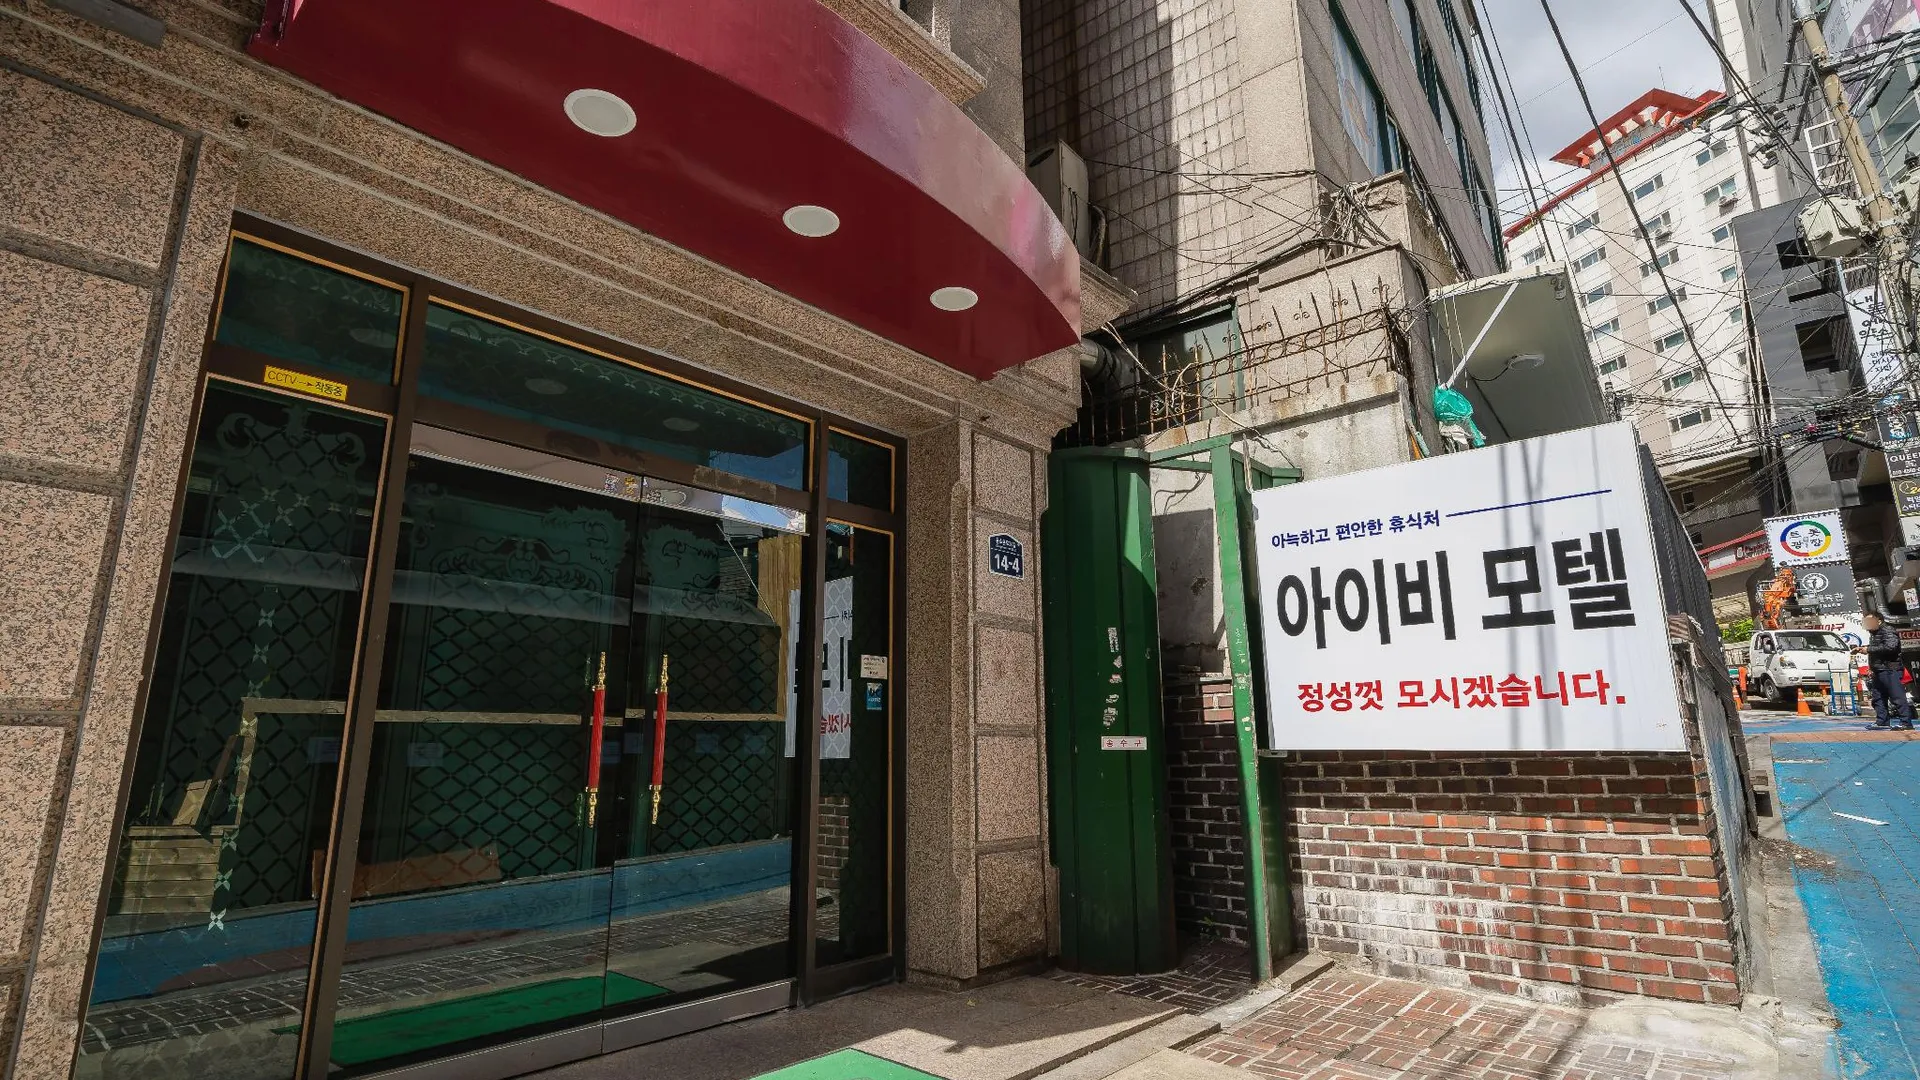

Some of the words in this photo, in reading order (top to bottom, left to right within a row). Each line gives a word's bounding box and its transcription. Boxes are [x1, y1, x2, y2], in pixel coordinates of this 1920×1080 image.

[268, 371, 297, 384] CCTV
[315, 380, 342, 396] 작동중
[1890, 451, 1920, 463] QUEE
[1272, 529, 1330, 548] 아늑하고
[1336, 518, 1383, 540] 편안한
[1389, 509, 1440, 533] 휴식처
[994, 553, 1020, 573] 14-4
[1277, 550, 1456, 649] 아이비
[1482, 528, 1636, 630] 모텔
[1297, 680, 1384, 712] 정성껏
[1397, 669, 1626, 709] 모시겠습니다.
